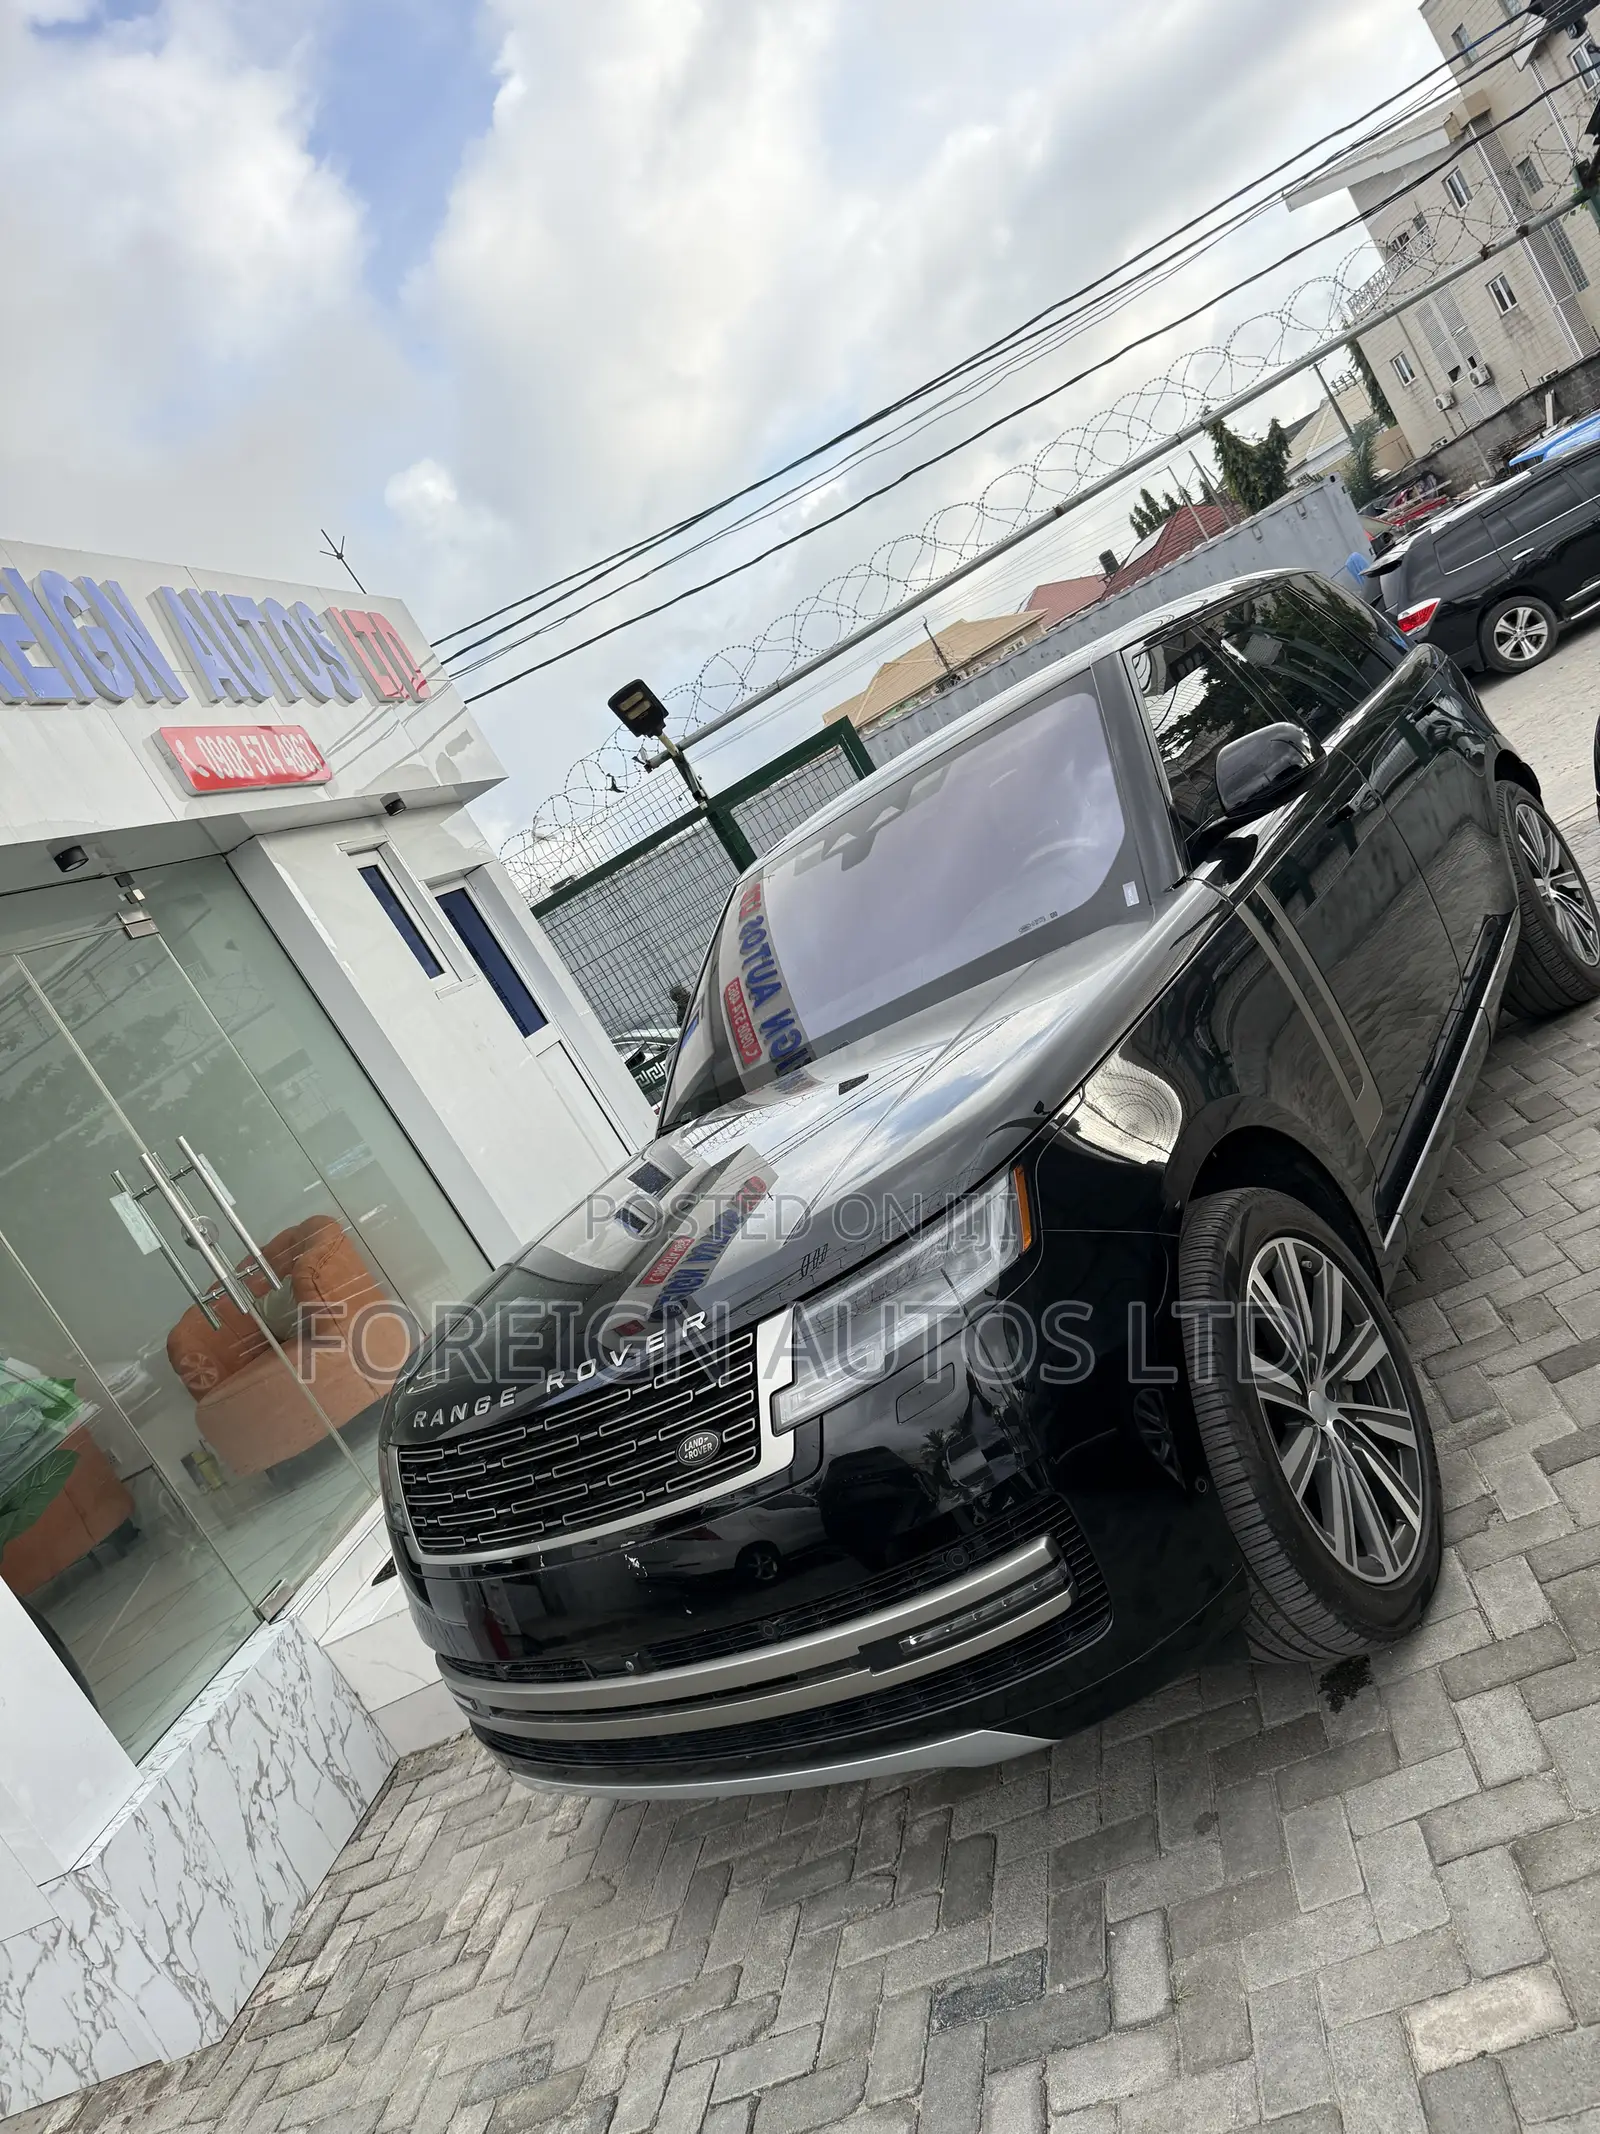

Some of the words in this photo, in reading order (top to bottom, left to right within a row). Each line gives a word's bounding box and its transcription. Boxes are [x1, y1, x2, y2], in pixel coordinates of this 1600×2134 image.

[148, 585, 362, 703] AUTOS
[323, 606, 431, 703] LTD
[196, 735, 254, 779] 0908
[240, 735, 287, 776] 574
[413, 1386, 517, 1428] RANGE
[546, 1311, 706, 1393] ROVER
[684, 1437, 704, 1451] LAND
[688, 1442, 713, 1459] ROVER
